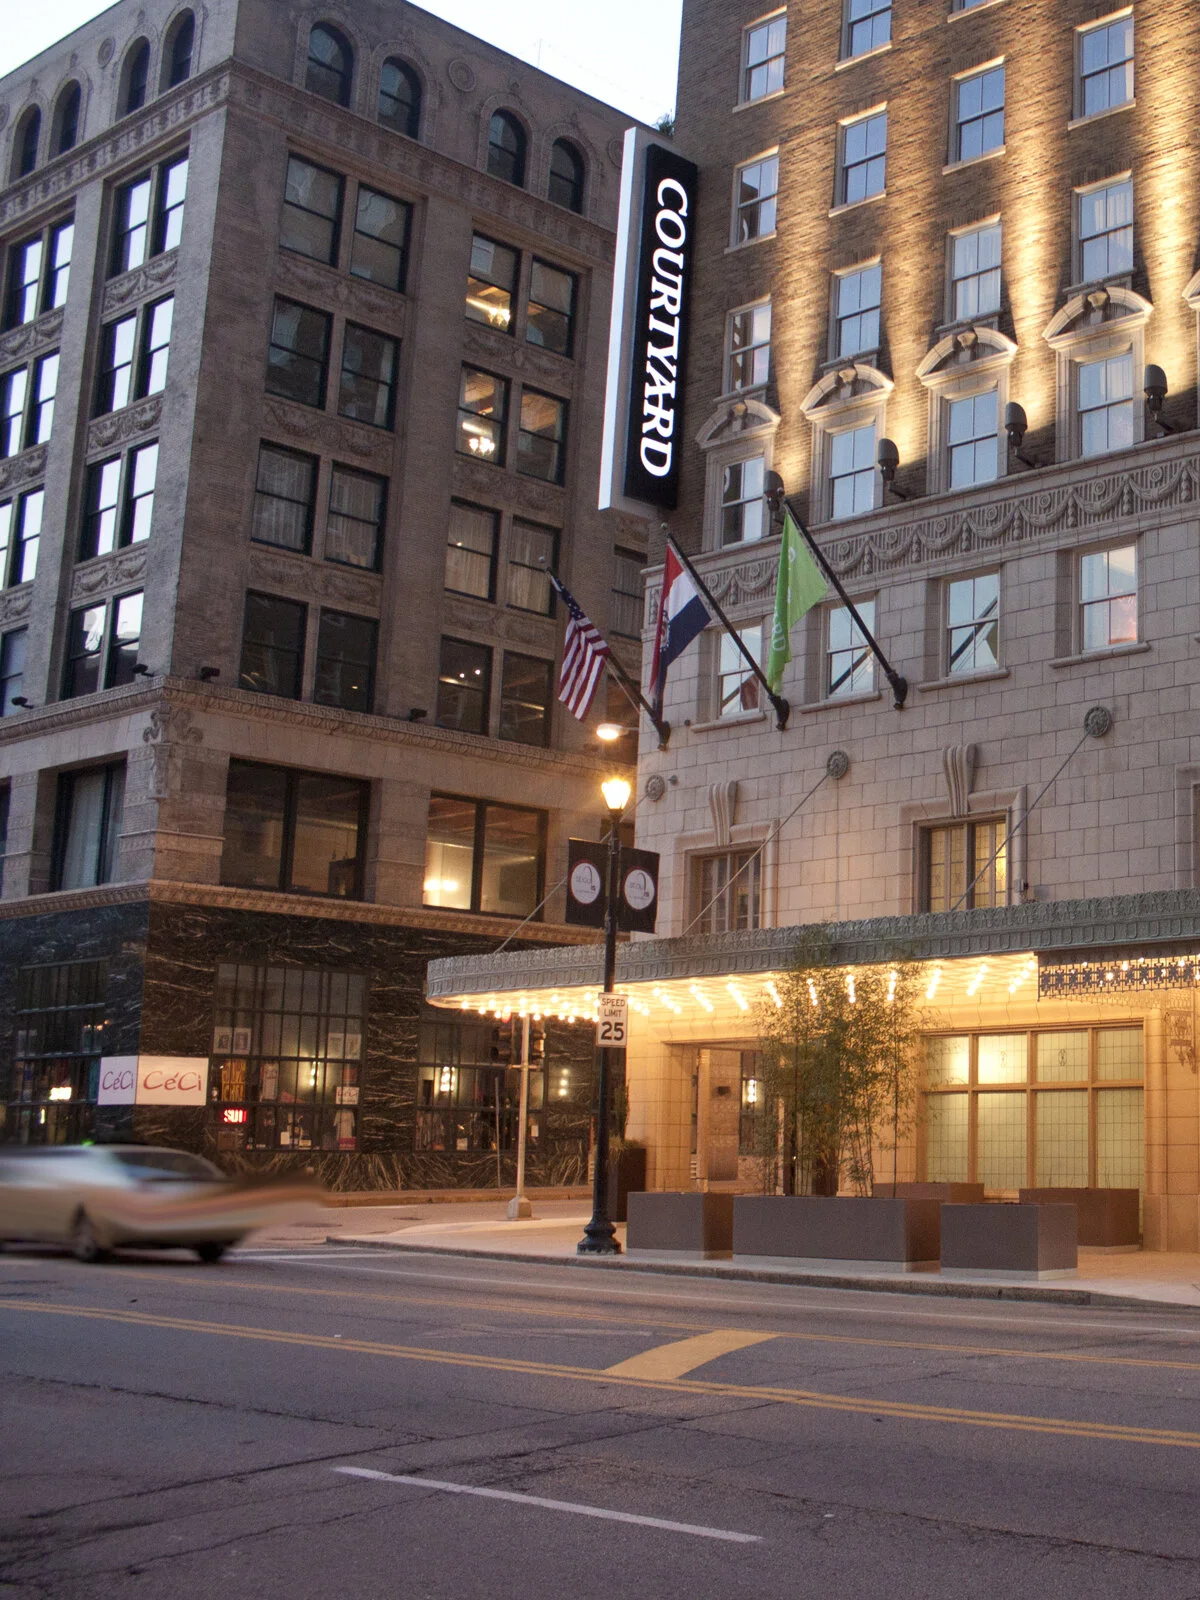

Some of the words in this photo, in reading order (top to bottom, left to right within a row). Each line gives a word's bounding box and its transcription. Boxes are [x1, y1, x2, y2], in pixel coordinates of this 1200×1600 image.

[639, 176, 688, 478] COURTYARD
[601, 998, 626, 1007] SPEED
[603, 1009, 622, 1017] LIMIT
[601, 1021, 625, 1041] 25
[142, 1069, 202, 1091] CéCi
